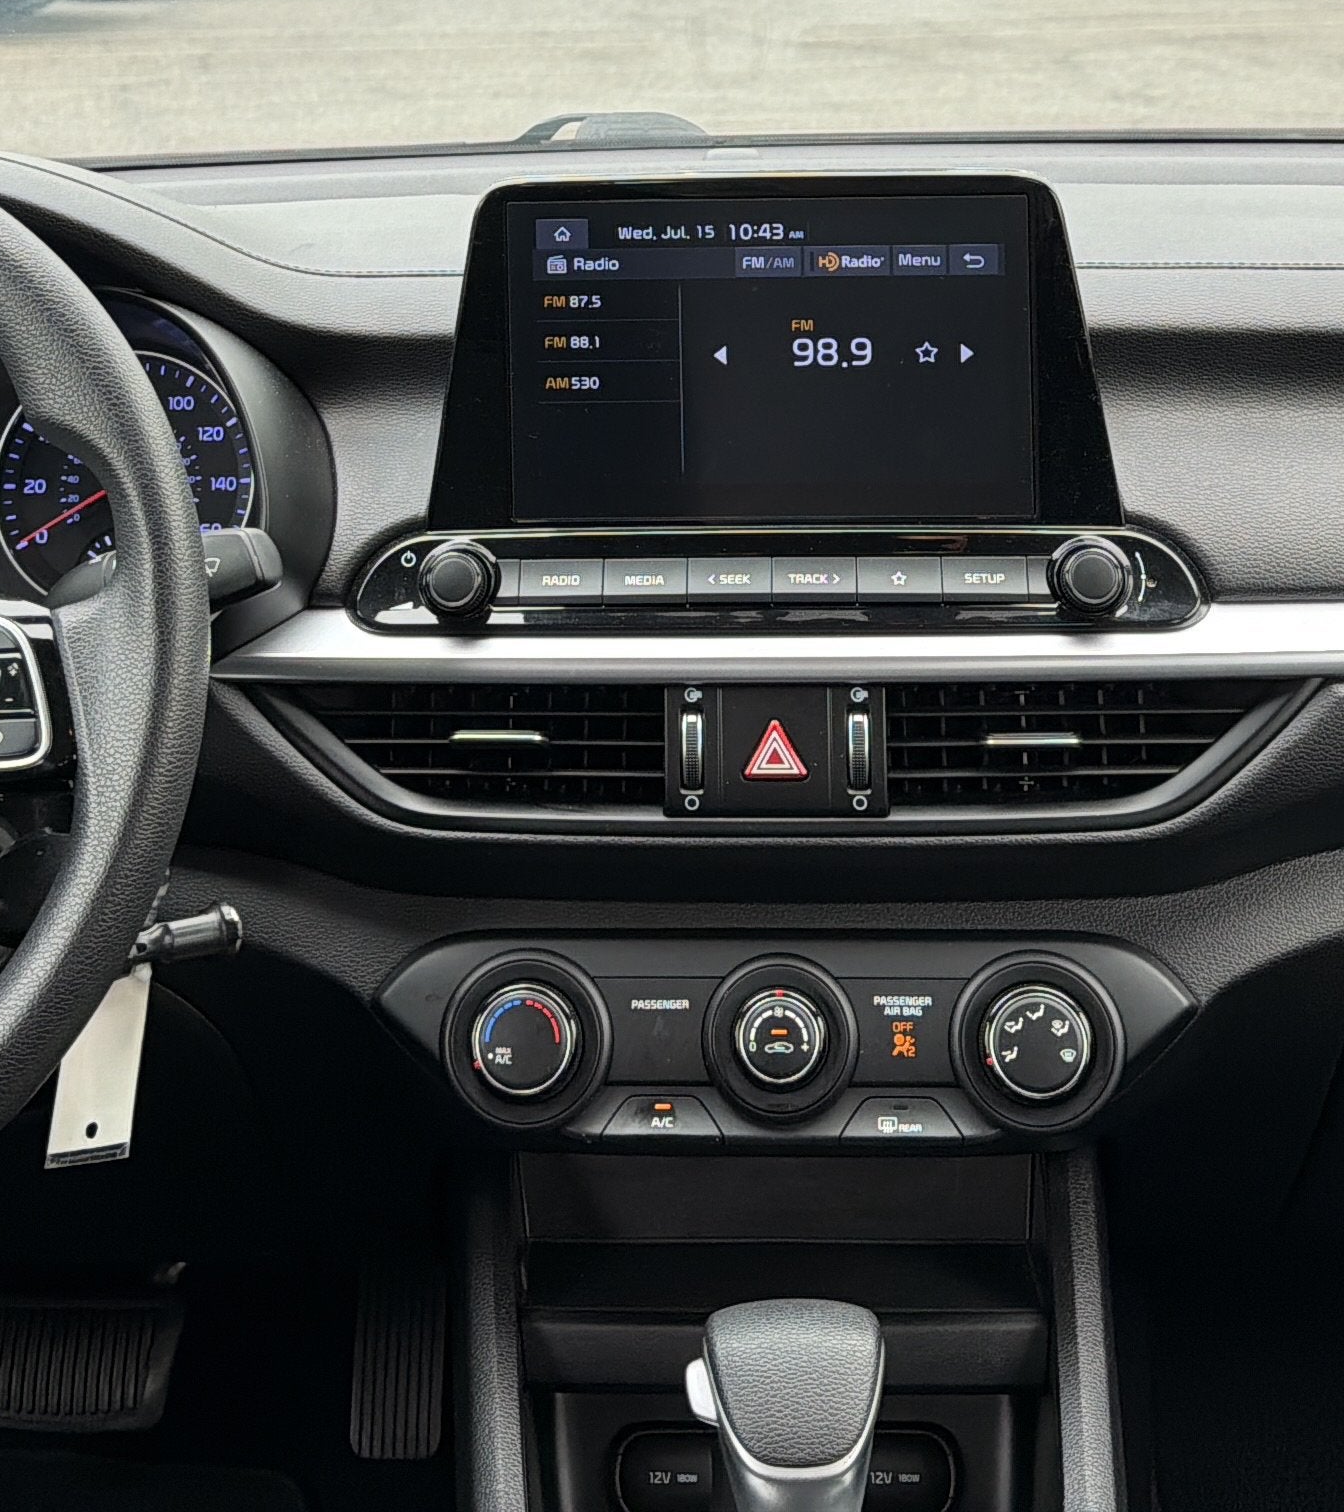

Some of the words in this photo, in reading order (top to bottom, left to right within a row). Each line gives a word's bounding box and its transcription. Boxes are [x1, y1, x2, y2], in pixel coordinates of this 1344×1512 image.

[695, 224, 716, 240] 15
[728, 221, 785, 240] 10:43
[788, 230, 805, 239] AM
[573, 255, 620, 271] Radio
[742, 256, 795, 270] FM/AM
[898, 253, 941, 267] Menu
[543, 295, 566, 308] FM
[569, 294, 602, 310] 87.5
[791, 319, 814, 332] FM
[544, 335, 567, 349] FM
[569, 335, 601, 350] 88.1
[791, 337, 874, 369] 98.9
[545, 375, 569, 389] AM
[571, 375, 600, 389] 530
[168, 396, 195, 411] 100
[197, 426, 225, 442] 120
[23, 479, 47, 494] 20
[210, 476, 237, 492] 140
[35, 529, 49, 544] 0
[541, 574, 581, 586] RADIO
[624, 574, 665, 586] MEDIA
[719, 573, 752, 585] SEEK
[787, 573, 829, 585] TRACK
[964, 573, 1006, 584] SETUP
[631, 999, 690, 1011] PASSENGER
[873, 995, 933, 1007] PASSENGER
[883, 1006, 901, 1017] AIR
[902, 1006, 923, 1017] BAG
[892, 1022, 914, 1033] OFF
[495, 1054, 513, 1065] A/C
[650, 1117, 674, 1128] A/C
[898, 1123, 923, 1133] REAR
[649, 1471, 671, 1484] 12V
[870, 1471, 893, 1484] 12V
